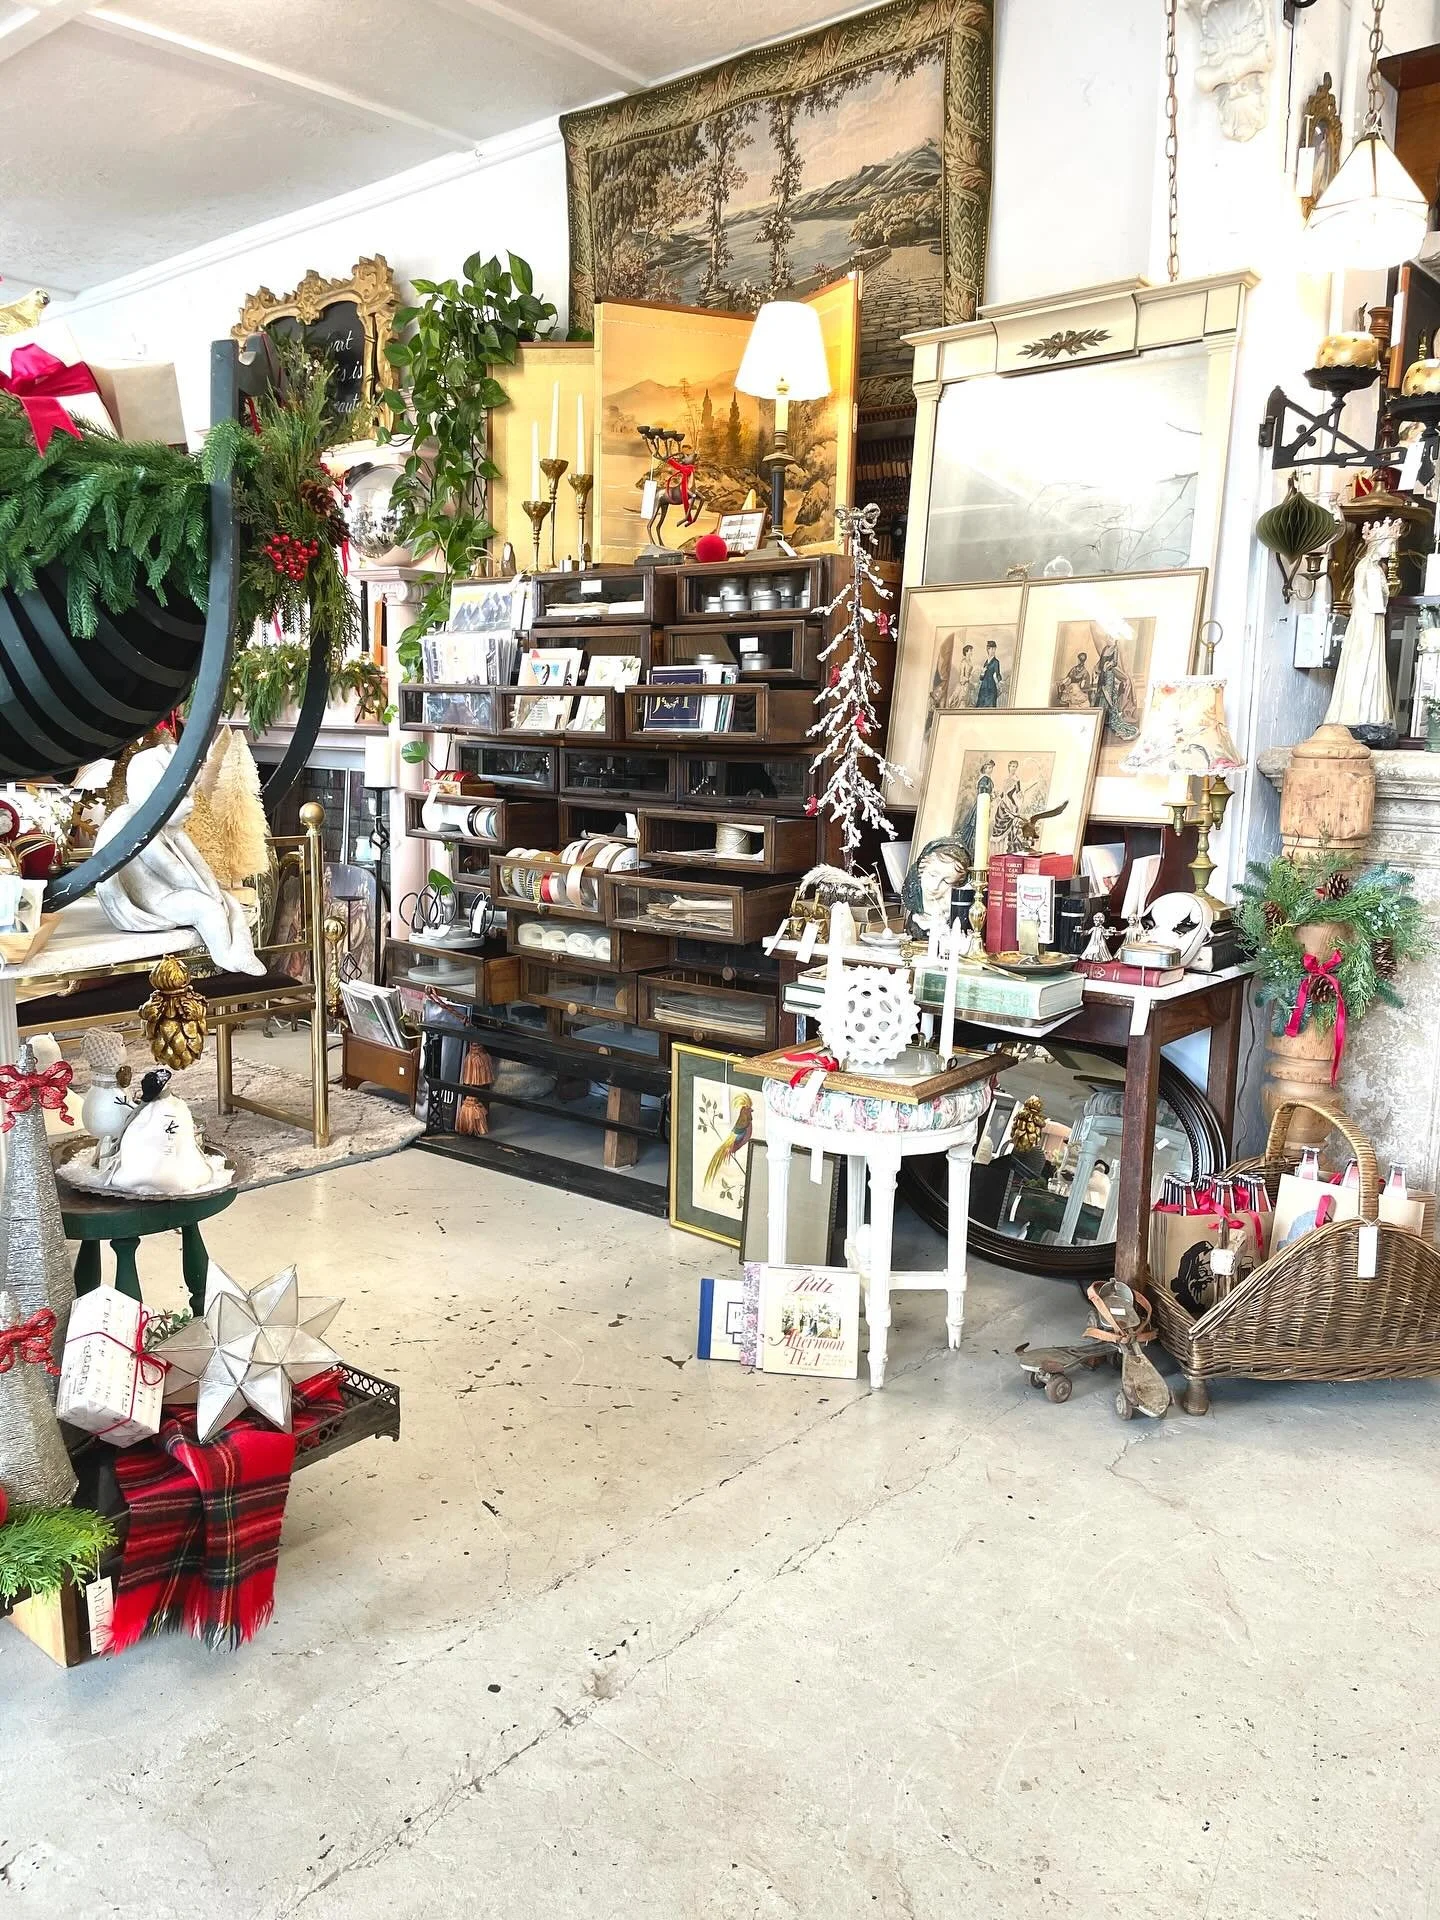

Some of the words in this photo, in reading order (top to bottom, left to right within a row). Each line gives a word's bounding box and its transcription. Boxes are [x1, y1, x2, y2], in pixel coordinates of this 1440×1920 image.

[788, 1271, 835, 1294] Ritz
[769, 1328, 845, 1351] Afternoon
[785, 1346, 821, 1367] TEA
